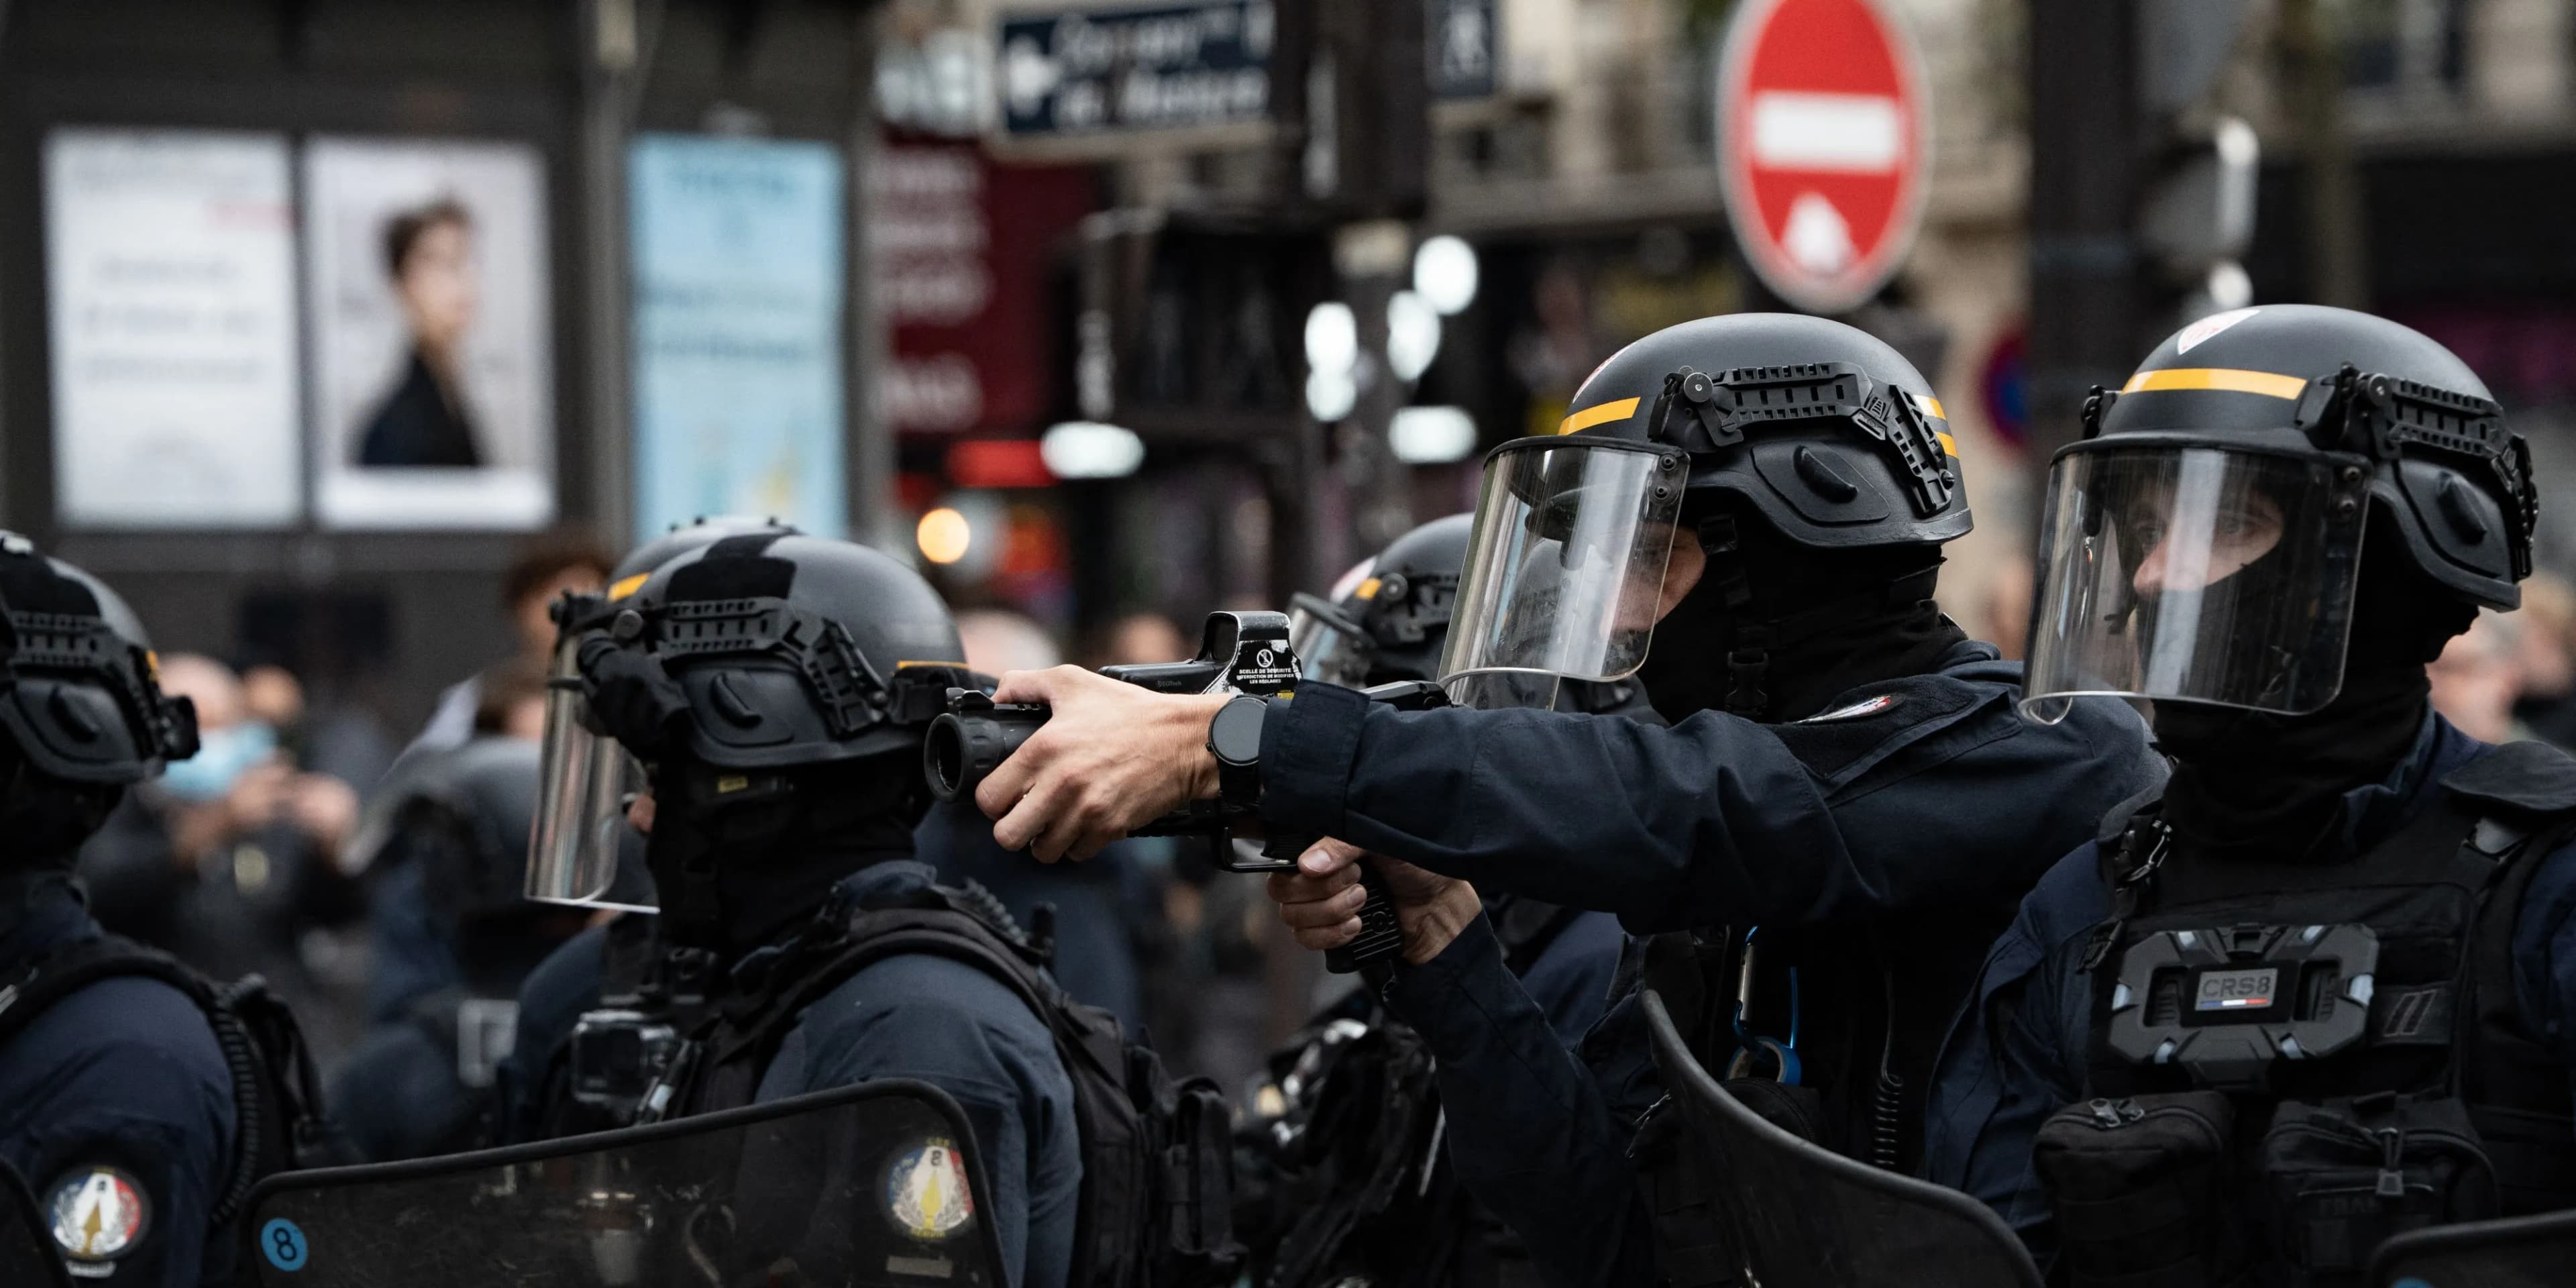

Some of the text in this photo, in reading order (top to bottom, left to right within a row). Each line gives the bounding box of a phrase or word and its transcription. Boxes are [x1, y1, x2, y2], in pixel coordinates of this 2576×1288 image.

[2202, 976, 2271, 998] CRS8
[930, 1150, 943, 1167] 8
[273, 1227, 298, 1262] 8
